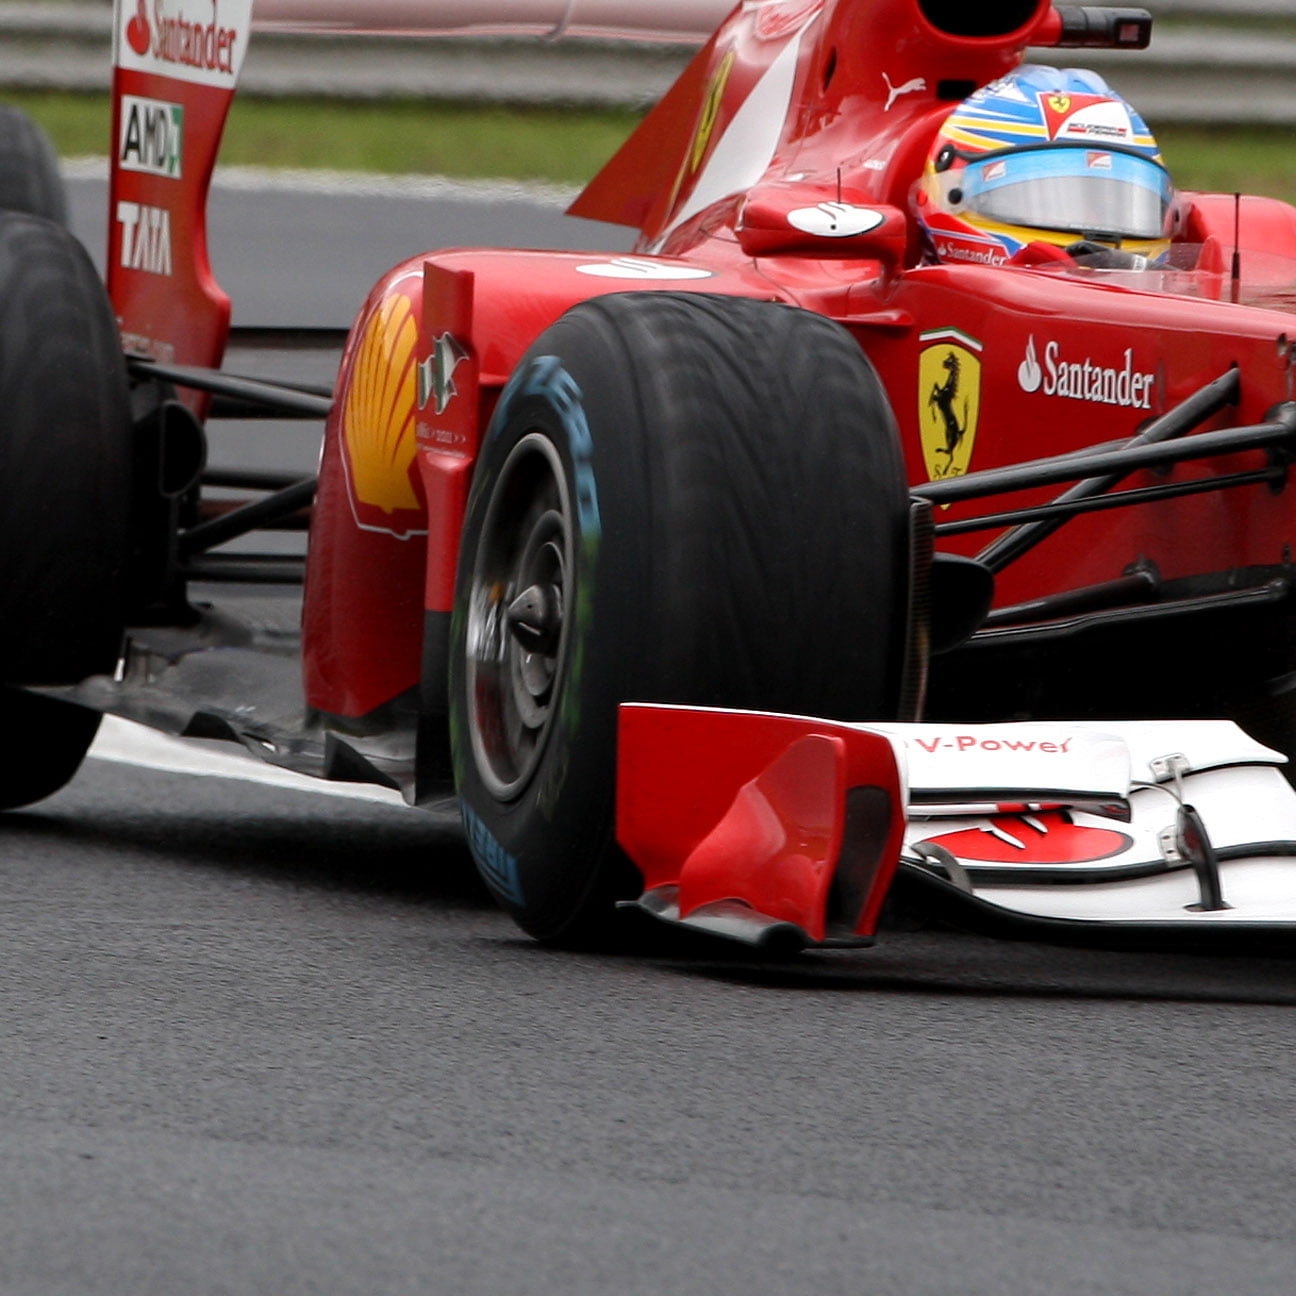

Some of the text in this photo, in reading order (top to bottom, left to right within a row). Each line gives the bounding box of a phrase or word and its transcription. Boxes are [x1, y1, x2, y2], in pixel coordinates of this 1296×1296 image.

[122, 103, 171, 169] AMD
[117, 201, 172, 277] TATA
[947, 241, 1008, 267] Santander
[1043, 340, 1154, 409] Santander
[914, 735, 1072, 754] V-Power
